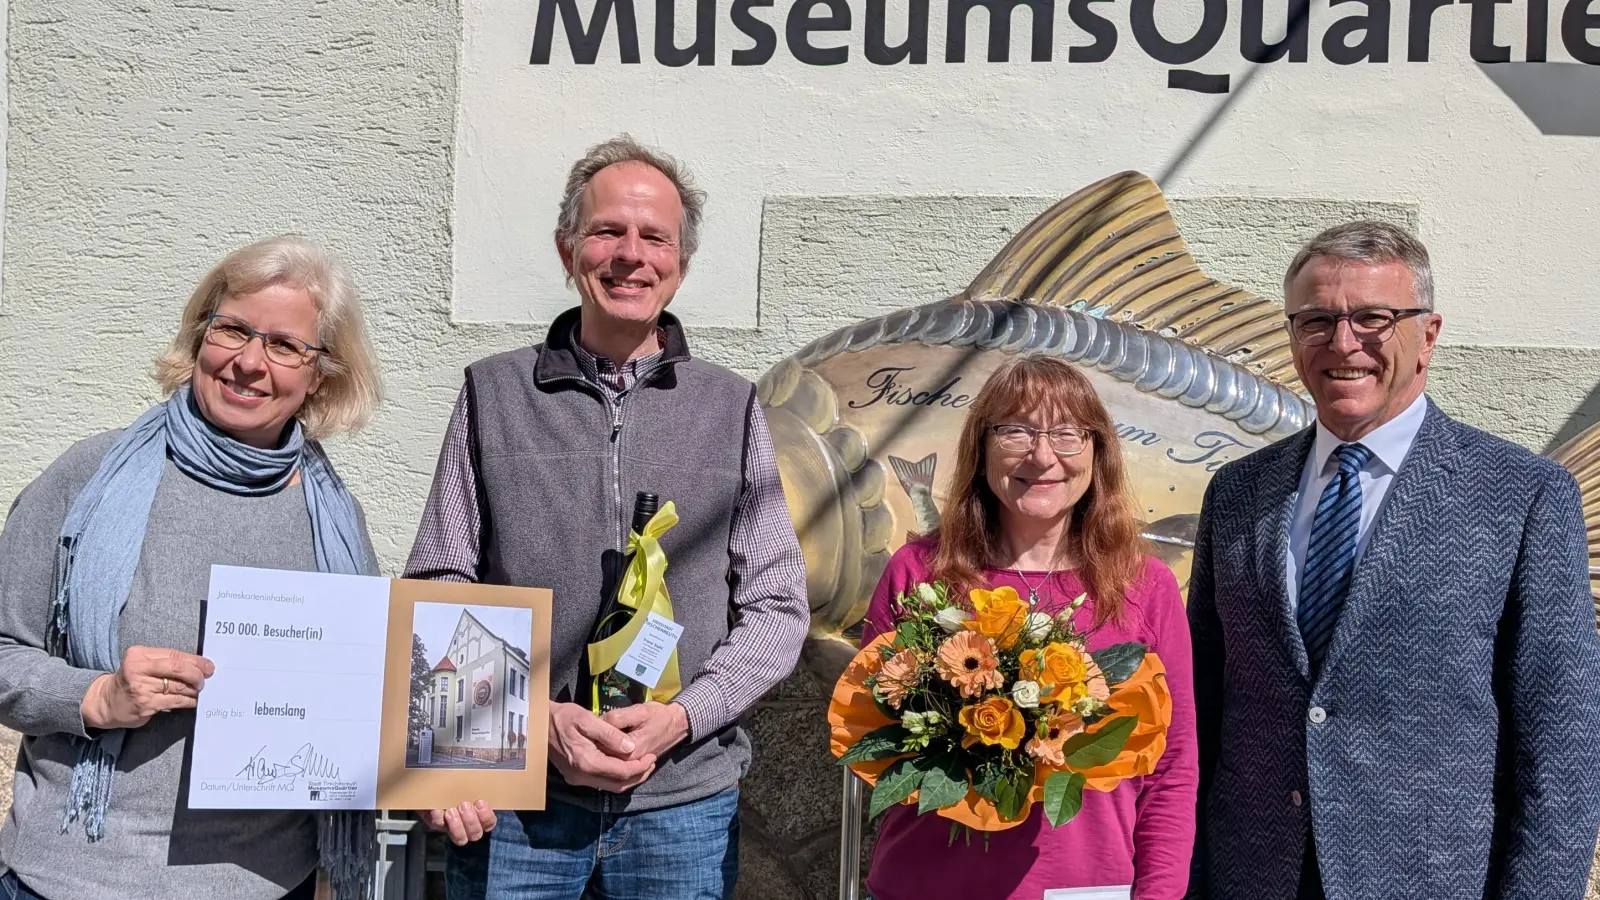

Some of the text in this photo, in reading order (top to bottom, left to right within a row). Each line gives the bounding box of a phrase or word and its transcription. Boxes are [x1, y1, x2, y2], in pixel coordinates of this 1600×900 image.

[848, 366, 978, 408] Fische
[216, 589, 305, 604] Jahreskarteninhaber(in)
[215, 621, 323, 641] 250 000. Besucher(in)
[205, 701, 306, 720] gültig bis: lebenslang
[200, 781, 295, 792] Datum/Unterschrift MQ
